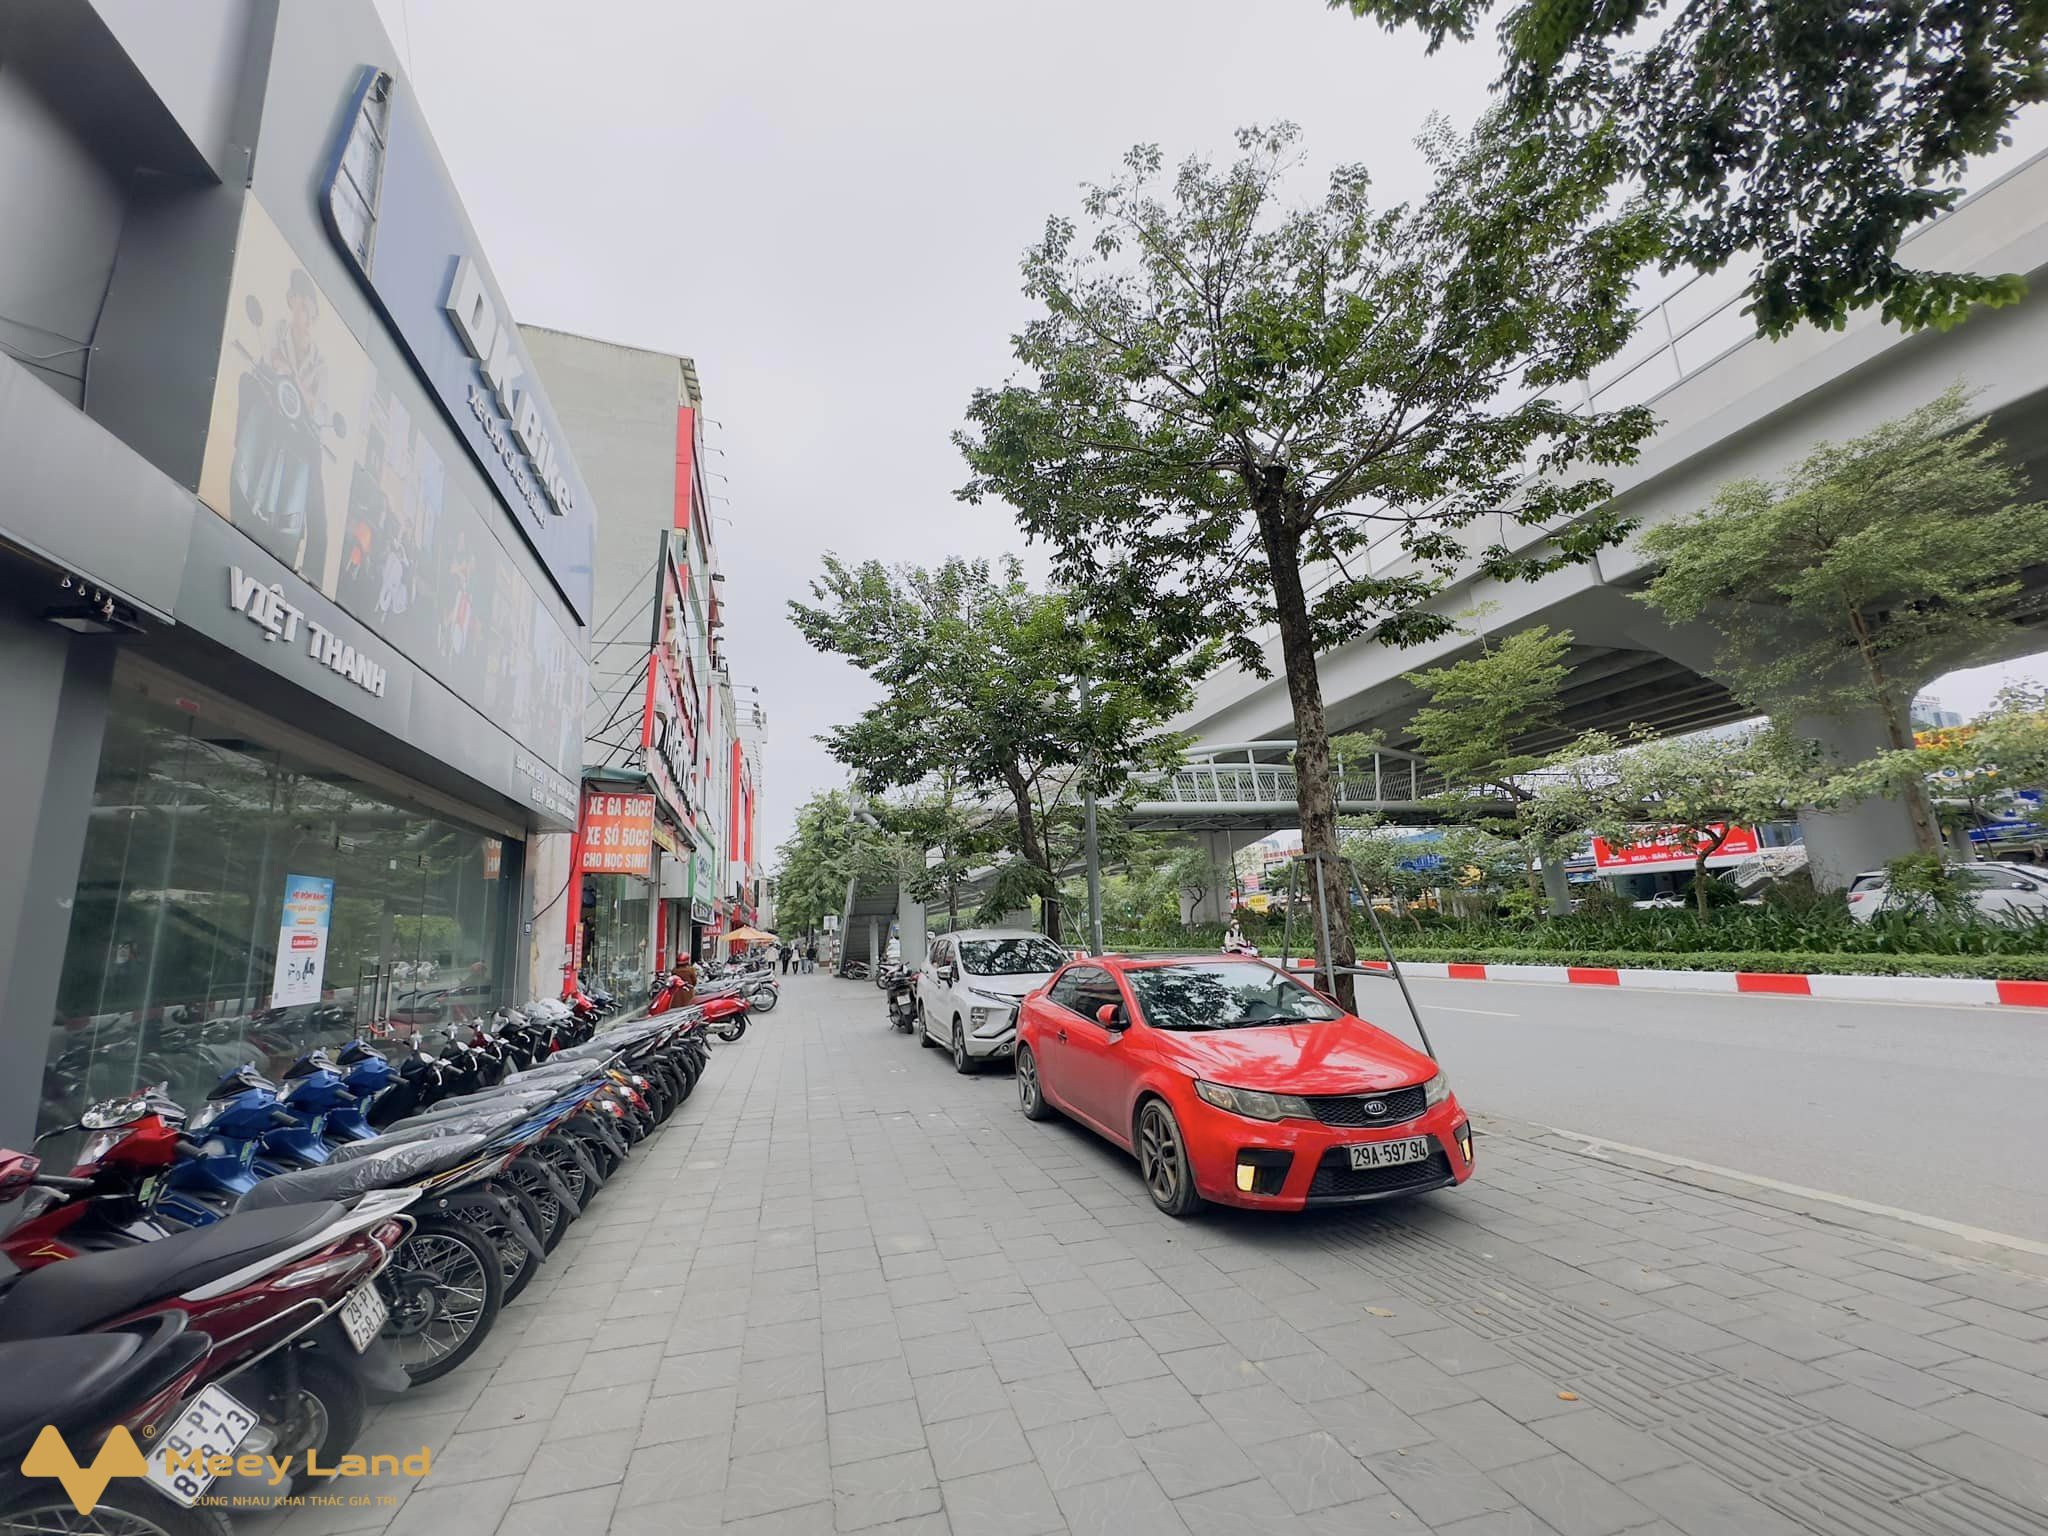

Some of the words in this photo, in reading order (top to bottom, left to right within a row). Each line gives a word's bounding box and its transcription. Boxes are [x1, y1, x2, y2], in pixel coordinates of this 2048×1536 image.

[229, 565, 305, 643] VIỆT
[307, 620, 386, 698] THANH
[589, 796, 605, 815] XE
[606, 797, 622, 816] GA
[624, 798, 652, 817] 50CC
[585, 826, 602, 845] XE
[622, 827, 650, 847] 50CC
[582, 852, 602, 867] CHO
[624, 853, 648, 868] SINH
[1353, 1140, 1427, 1167] 29A-597.94
